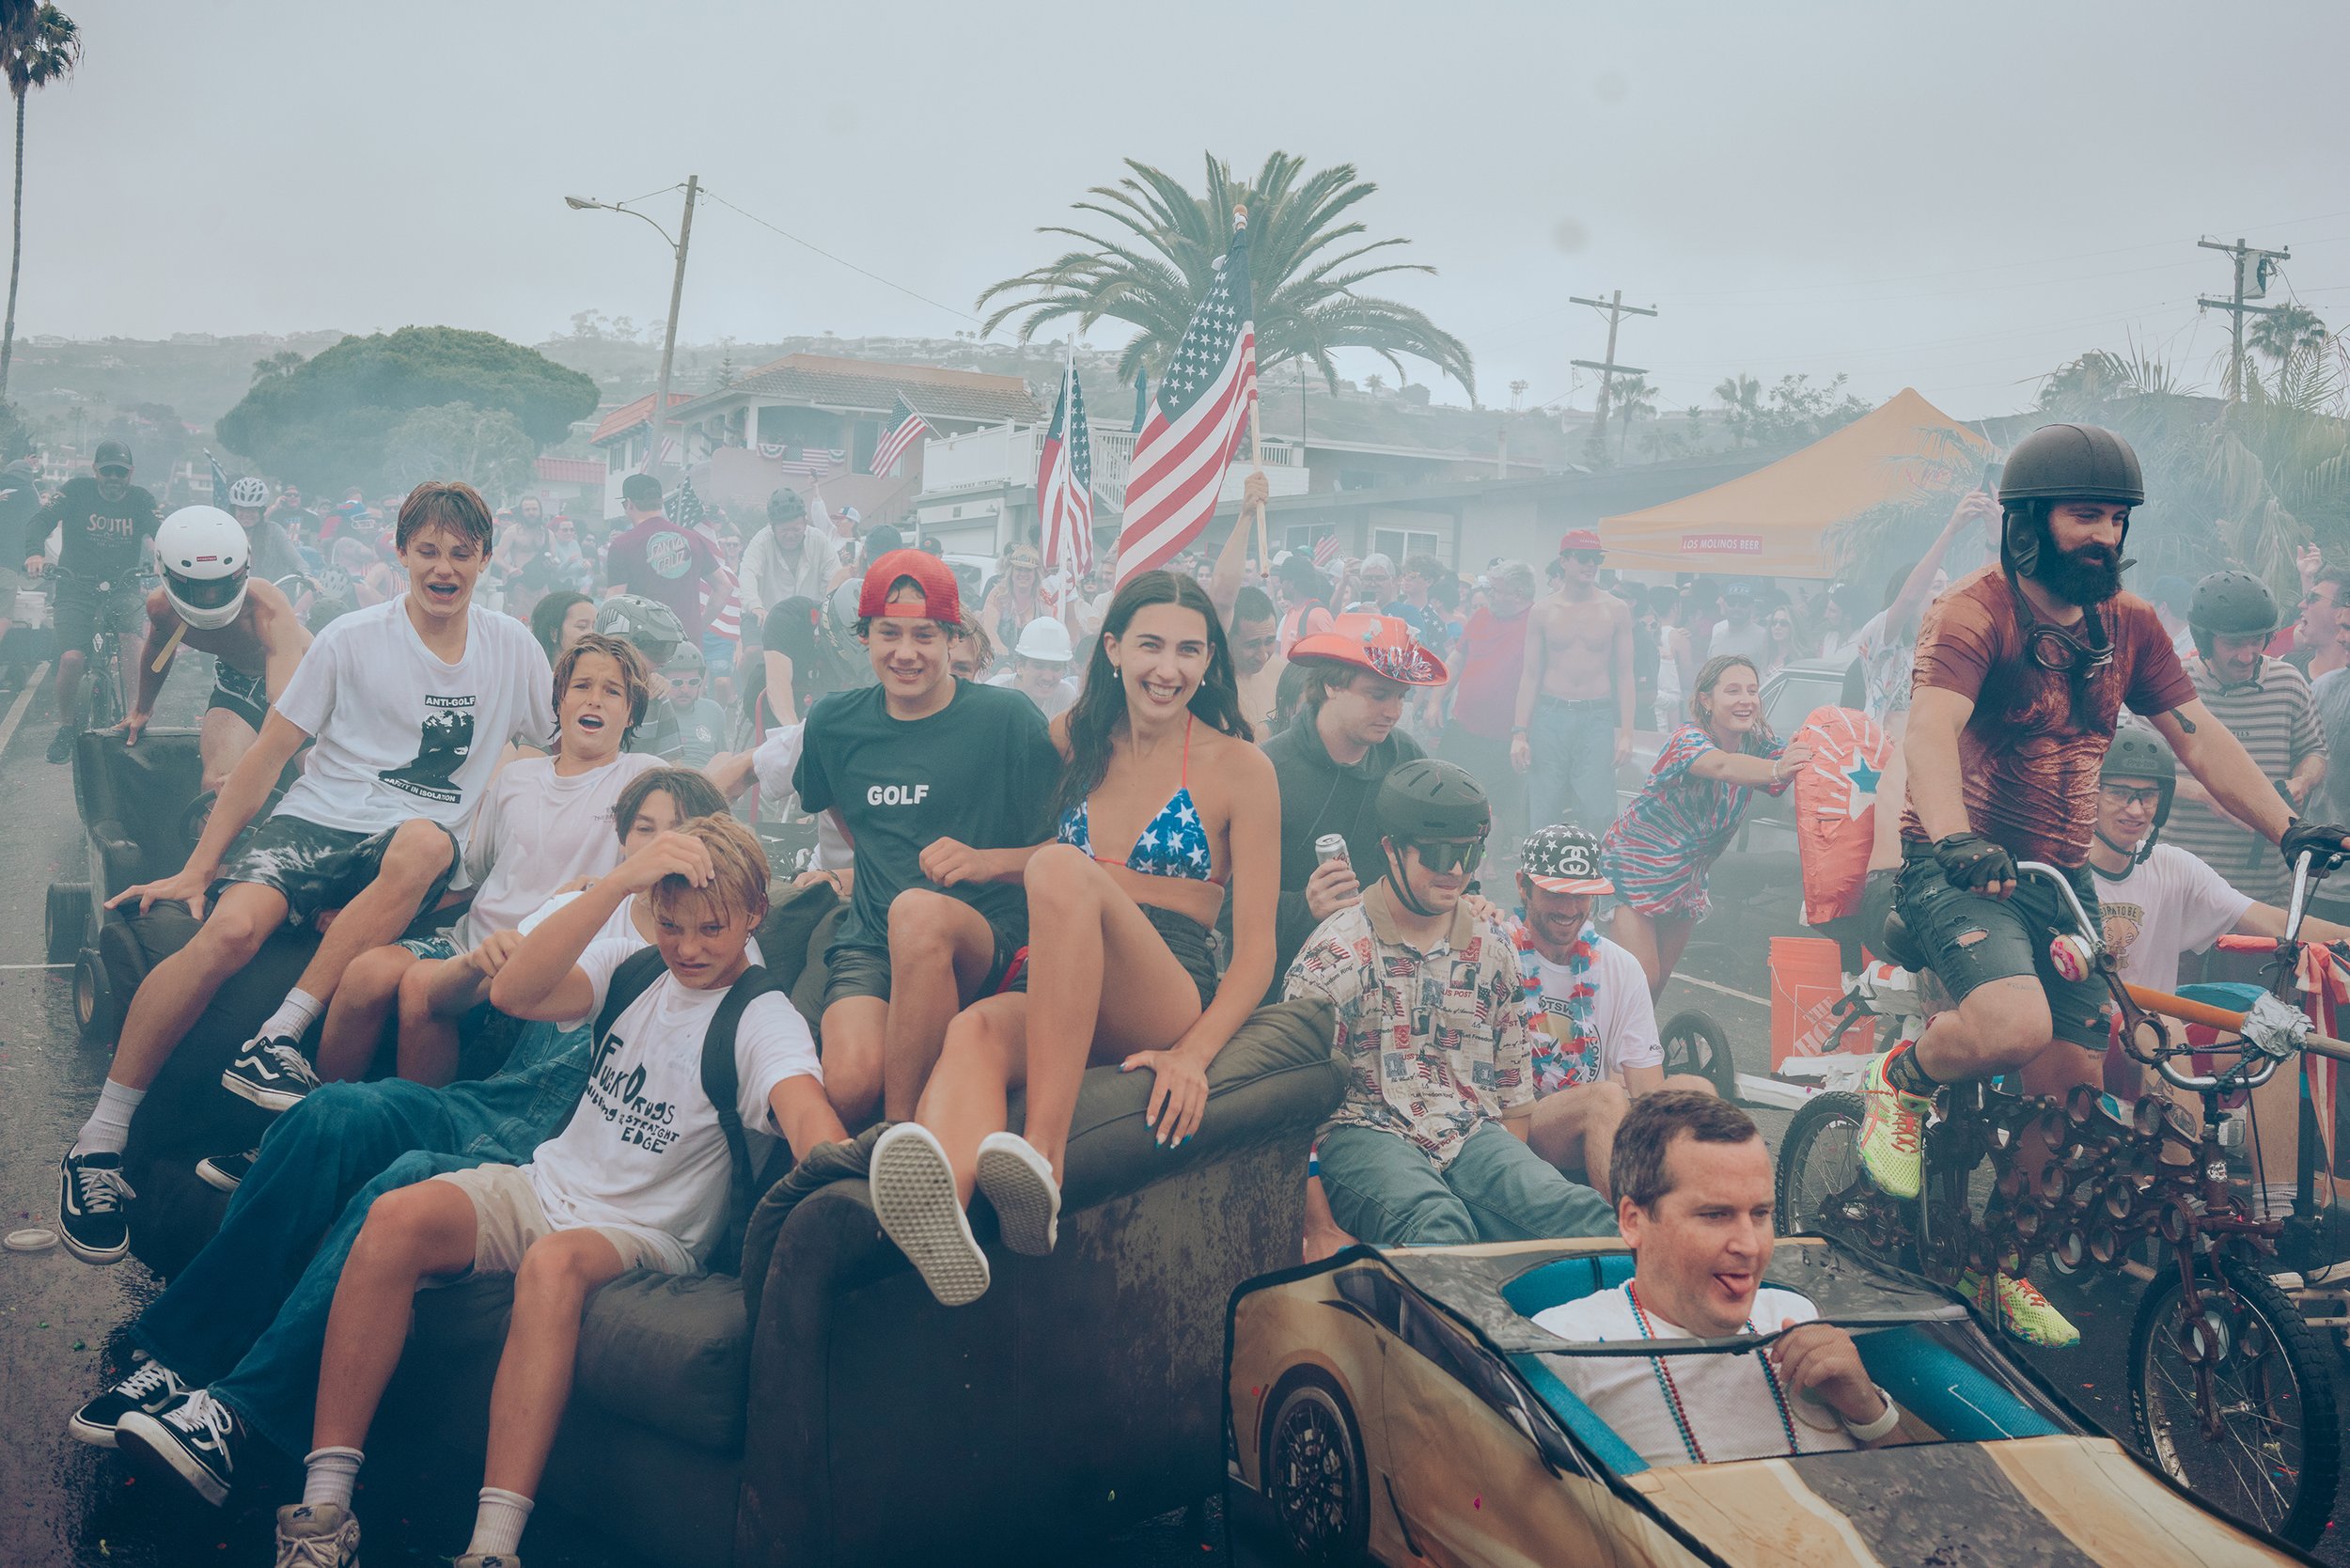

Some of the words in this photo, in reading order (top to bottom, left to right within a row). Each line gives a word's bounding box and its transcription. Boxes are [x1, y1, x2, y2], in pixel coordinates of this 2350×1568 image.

[86, 513, 134, 537] SOUTH
[647, 536, 685, 563] SANTA
[1683, 540, 1698, 550] LOS
[1700, 539, 1737, 550] MOLINOS
[1739, 540, 1760, 550] BEER
[657, 549, 685, 574] CRUZ
[425, 696, 476, 707] ANTI-GOLF
[410, 787, 419, 795] IN
[867, 784, 930, 806] GOLF
[2127, 906, 2138, 917] BE
[1453, 990, 1473, 998] POST
[625, 1114, 680, 1142] STRAIGHT
[620, 1126, 667, 1154] EDGE
[1439, 1132, 1460, 1147] POST
